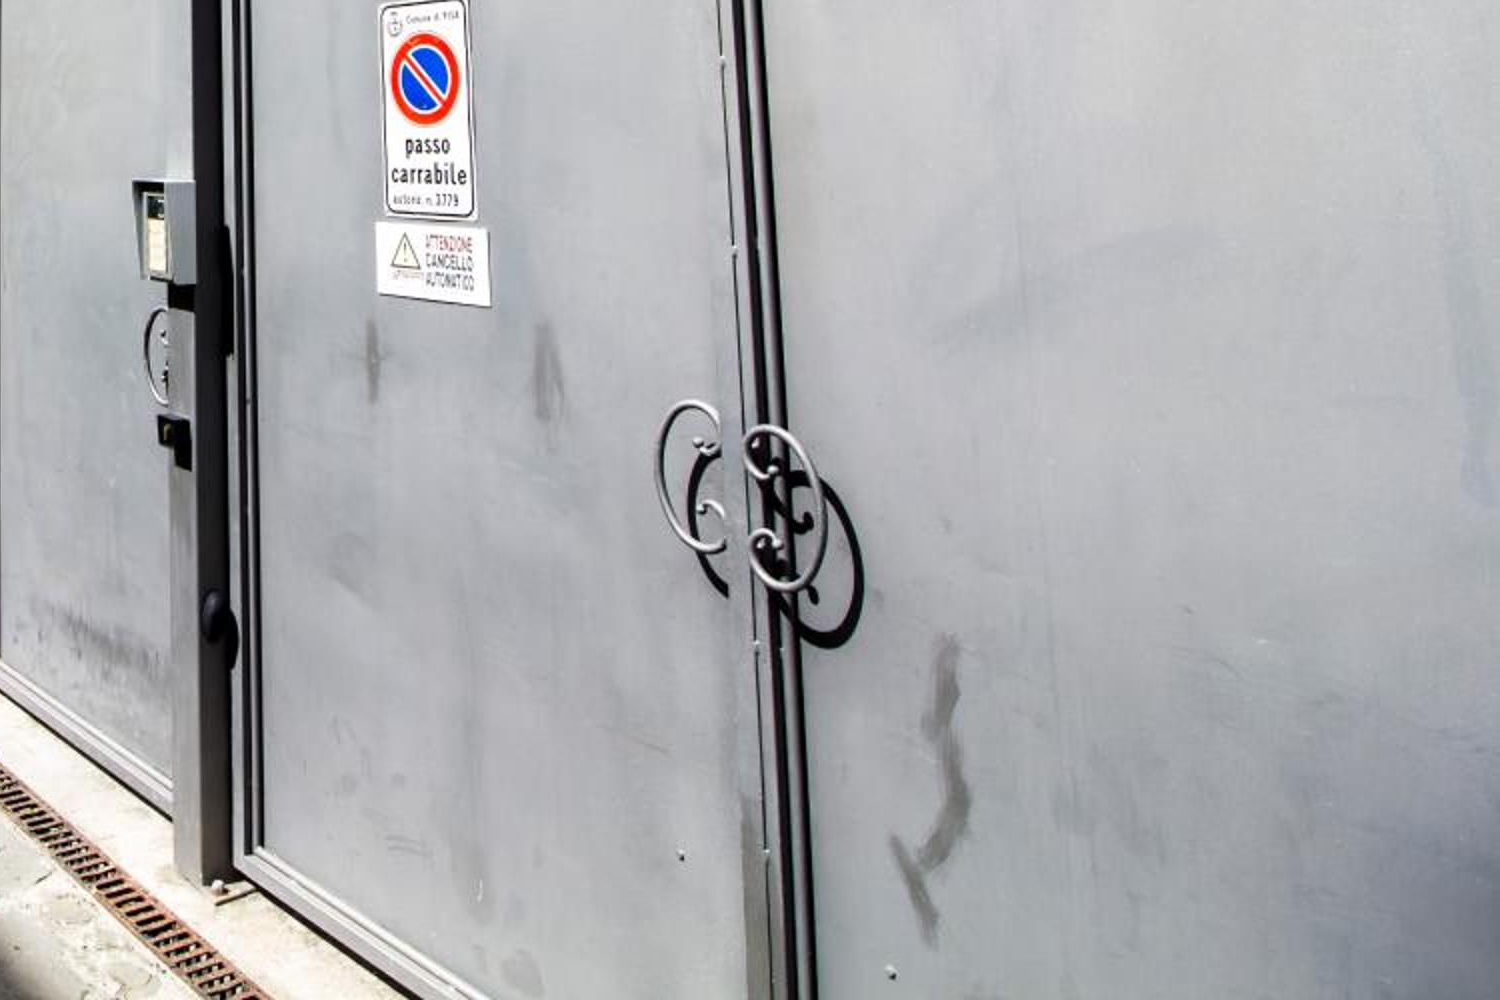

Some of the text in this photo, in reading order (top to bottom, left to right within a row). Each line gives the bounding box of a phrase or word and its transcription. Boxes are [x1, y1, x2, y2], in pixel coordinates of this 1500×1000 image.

[405, 138, 451, 159] passo
[391, 161, 467, 185] carrabile
[425, 252, 474, 272] CANCELLO
